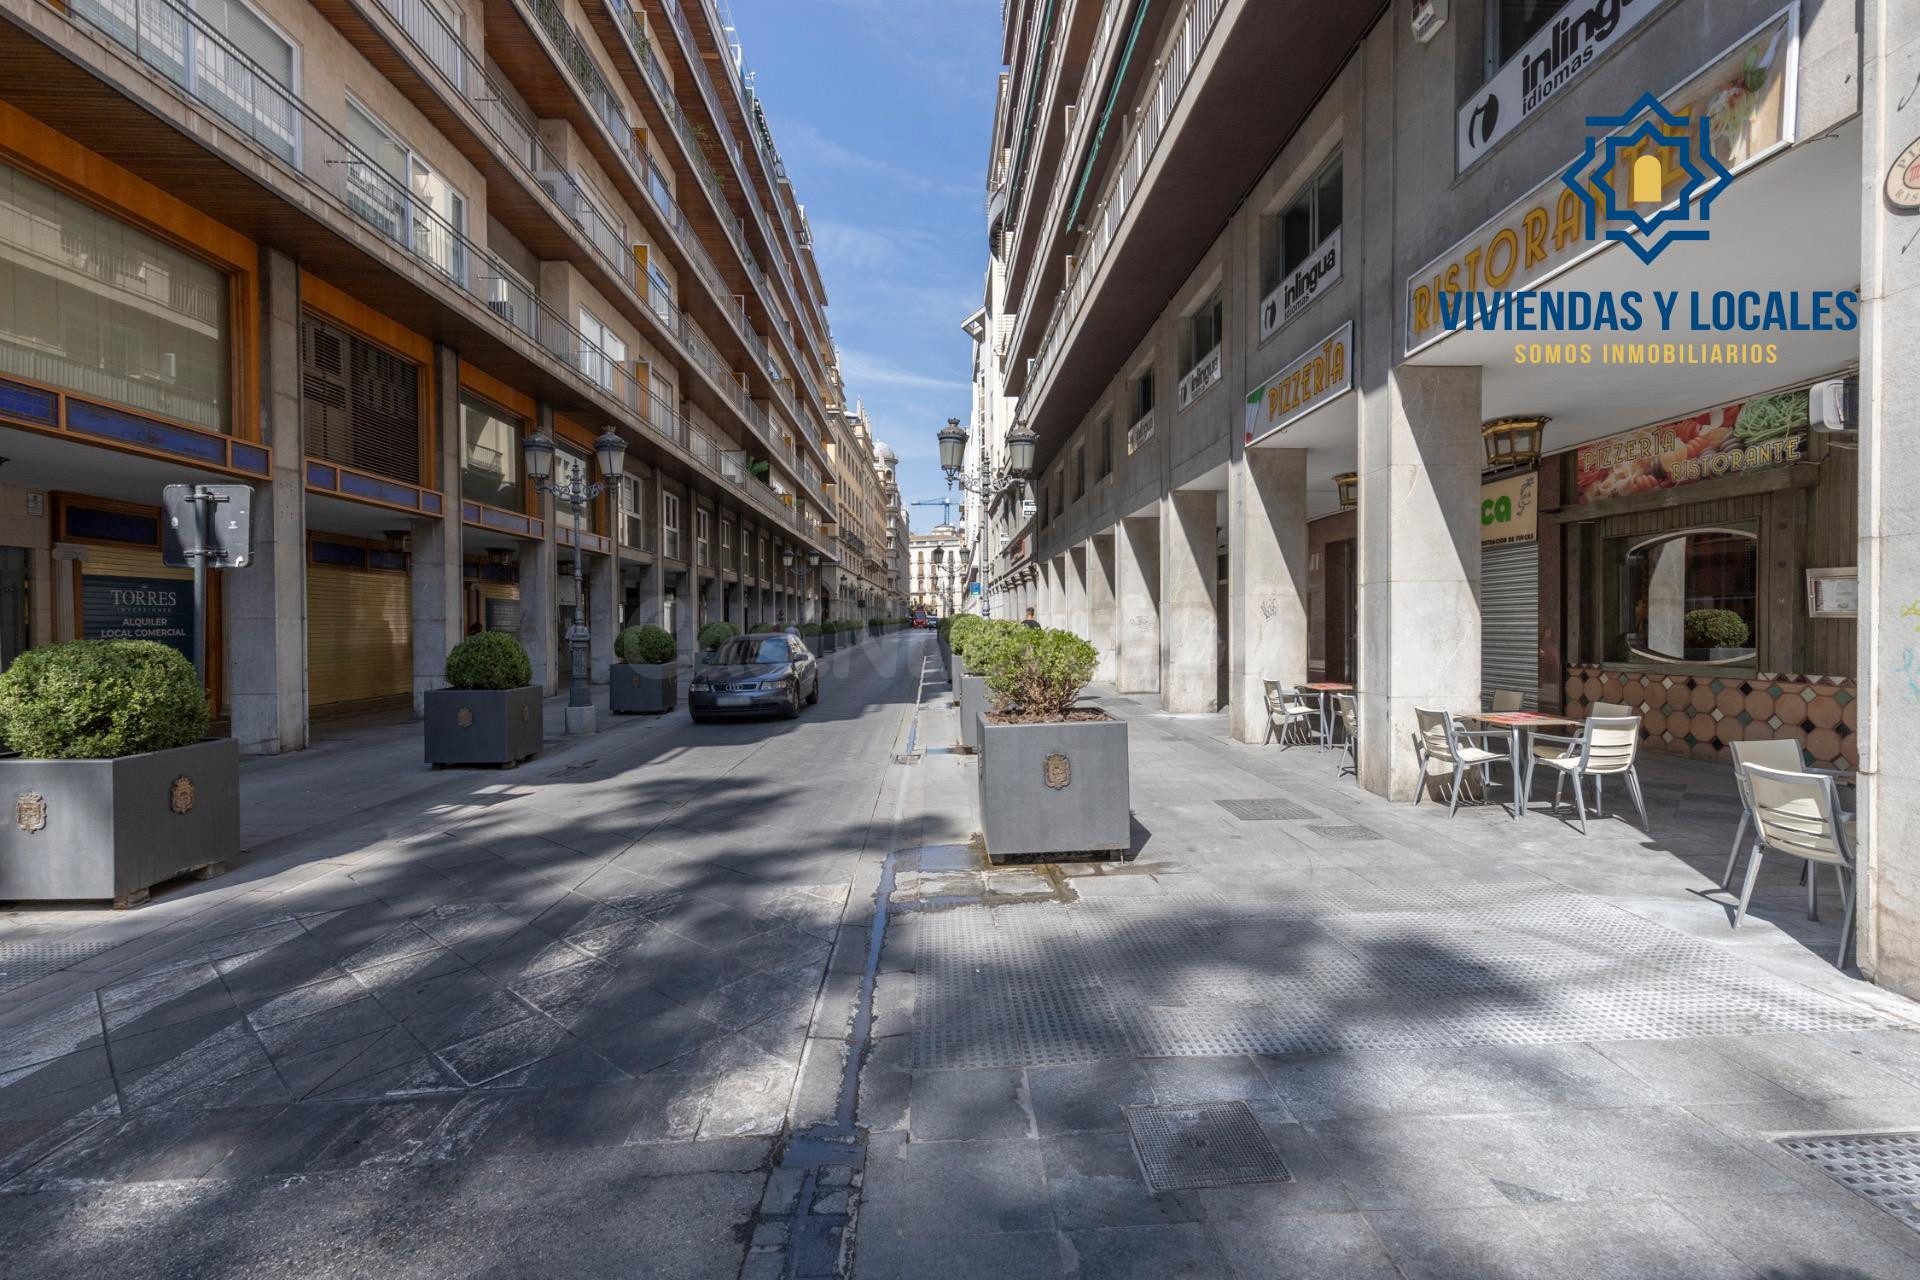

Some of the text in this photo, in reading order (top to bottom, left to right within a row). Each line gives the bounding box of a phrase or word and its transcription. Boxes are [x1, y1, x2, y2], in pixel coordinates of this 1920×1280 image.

[1522, 0, 1634, 97] inling
[1522, 44, 1594, 116] idiomas
[1284, 248, 1336, 309] inlingua
[1671, 437, 1801, 482] RISTORANTE
[110, 589, 177, 606] TORRES
[101, 628, 186, 638] LOCAL COMERCIAL
[122, 618, 168, 627] ALQUILER
